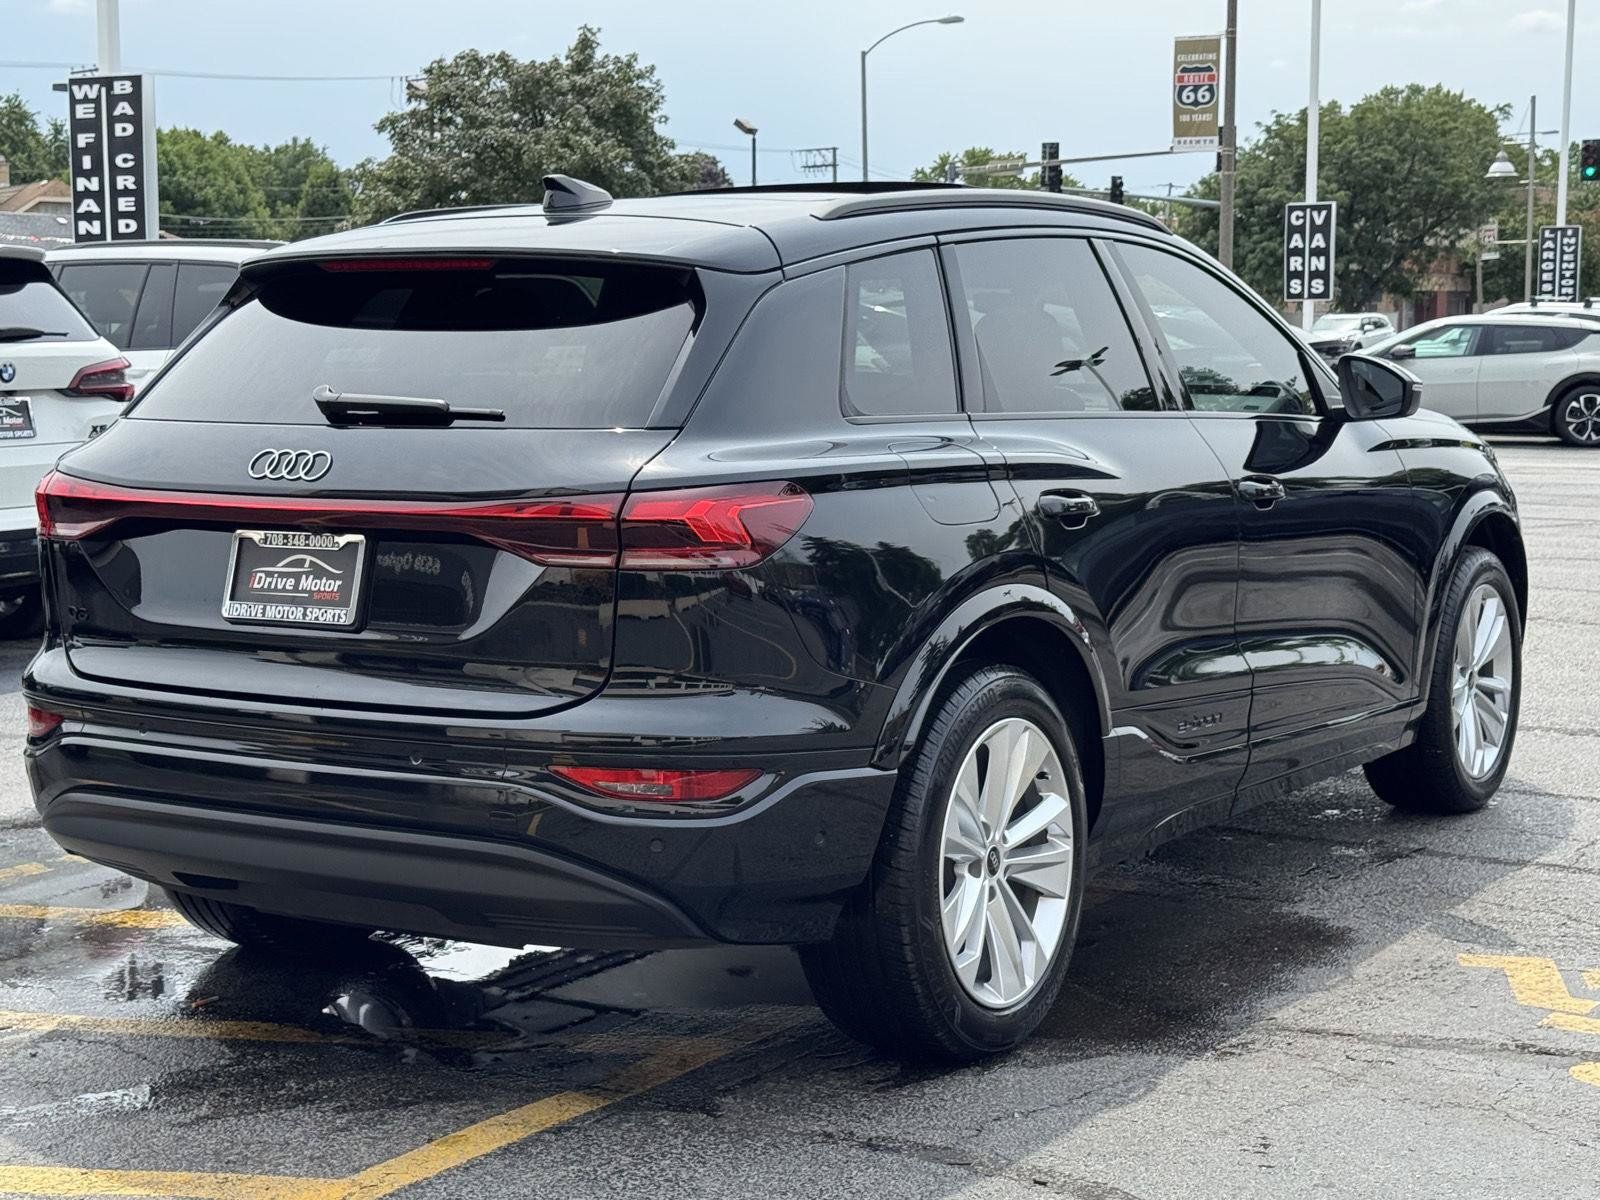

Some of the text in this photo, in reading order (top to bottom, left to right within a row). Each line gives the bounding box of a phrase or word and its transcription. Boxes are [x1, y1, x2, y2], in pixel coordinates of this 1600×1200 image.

[1177, 52, 1217, 61] CELEBRATING
[1181, 85, 1211, 104] 66
[71, 83, 101, 236] WE FINAN
[112, 80, 138, 234] BAD CRED
[1289, 209, 1304, 295] CARS
[1310, 209, 1328, 295] VANS
[265, 533, 334, 548] 708-348-0000
[248, 572, 343, 592] iDrive Motor
[312, 592, 341, 601] SPORTS
[264, 605, 304, 620] MOTOR
[305, 608, 347, 623] SPORTS
